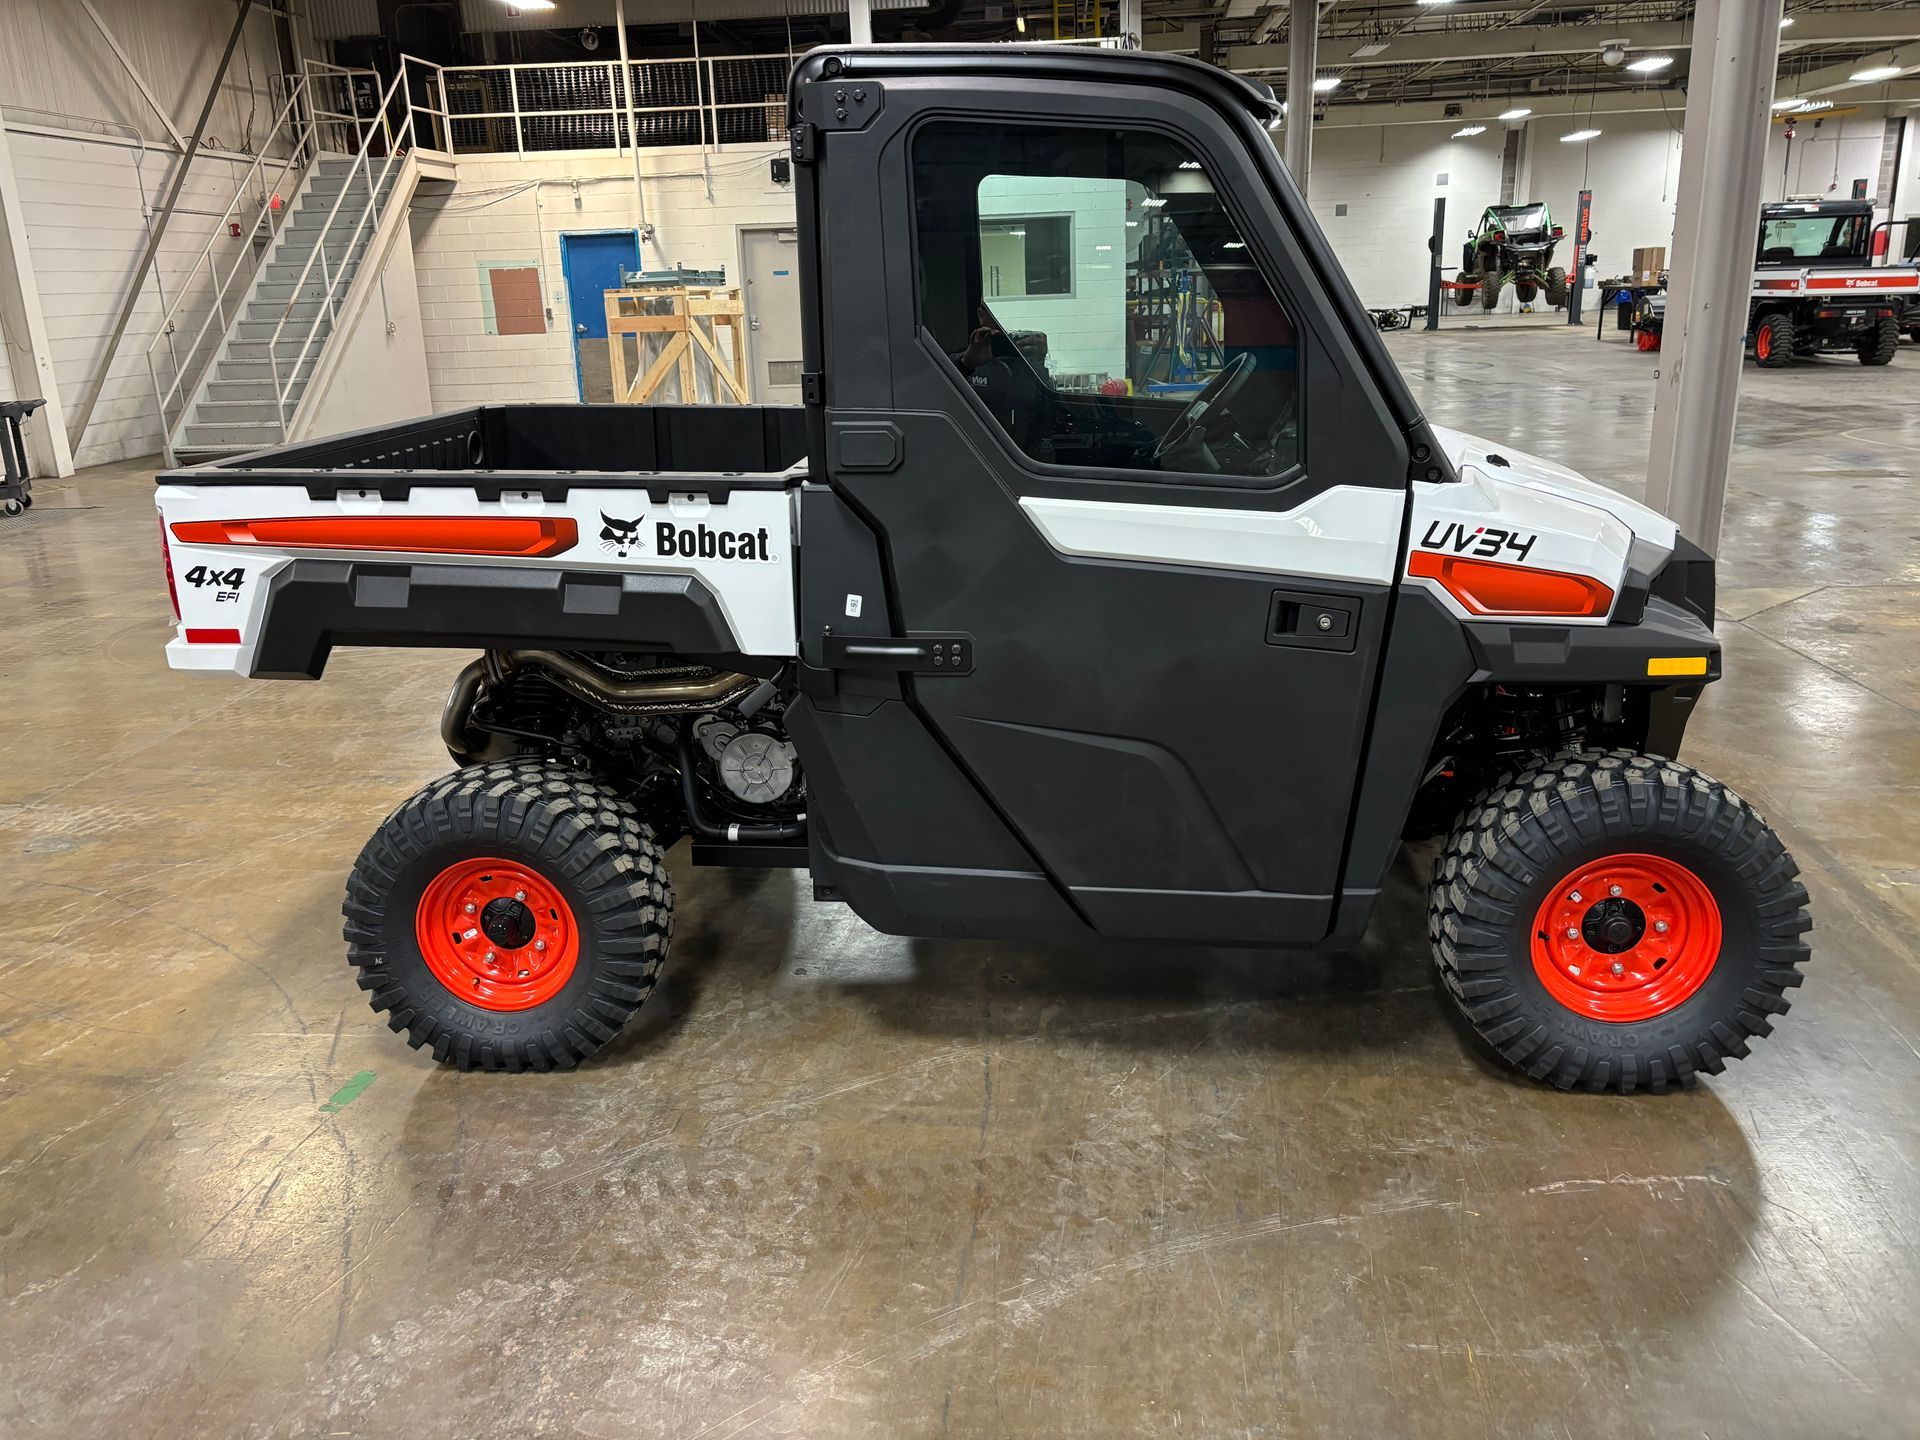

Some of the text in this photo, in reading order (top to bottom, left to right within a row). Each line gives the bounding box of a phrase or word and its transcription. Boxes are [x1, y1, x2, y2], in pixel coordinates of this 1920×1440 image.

[1581, 207, 1589, 241] STRATUS
[1856, 279, 1878, 287] Bobcat
[656, 522, 769, 561] Bobcat
[1420, 520, 1538, 562] UV34
[184, 566, 246, 590] 4x4
[215, 591, 240, 603] EFI
[420, 987, 520, 1035] CRAWLER
